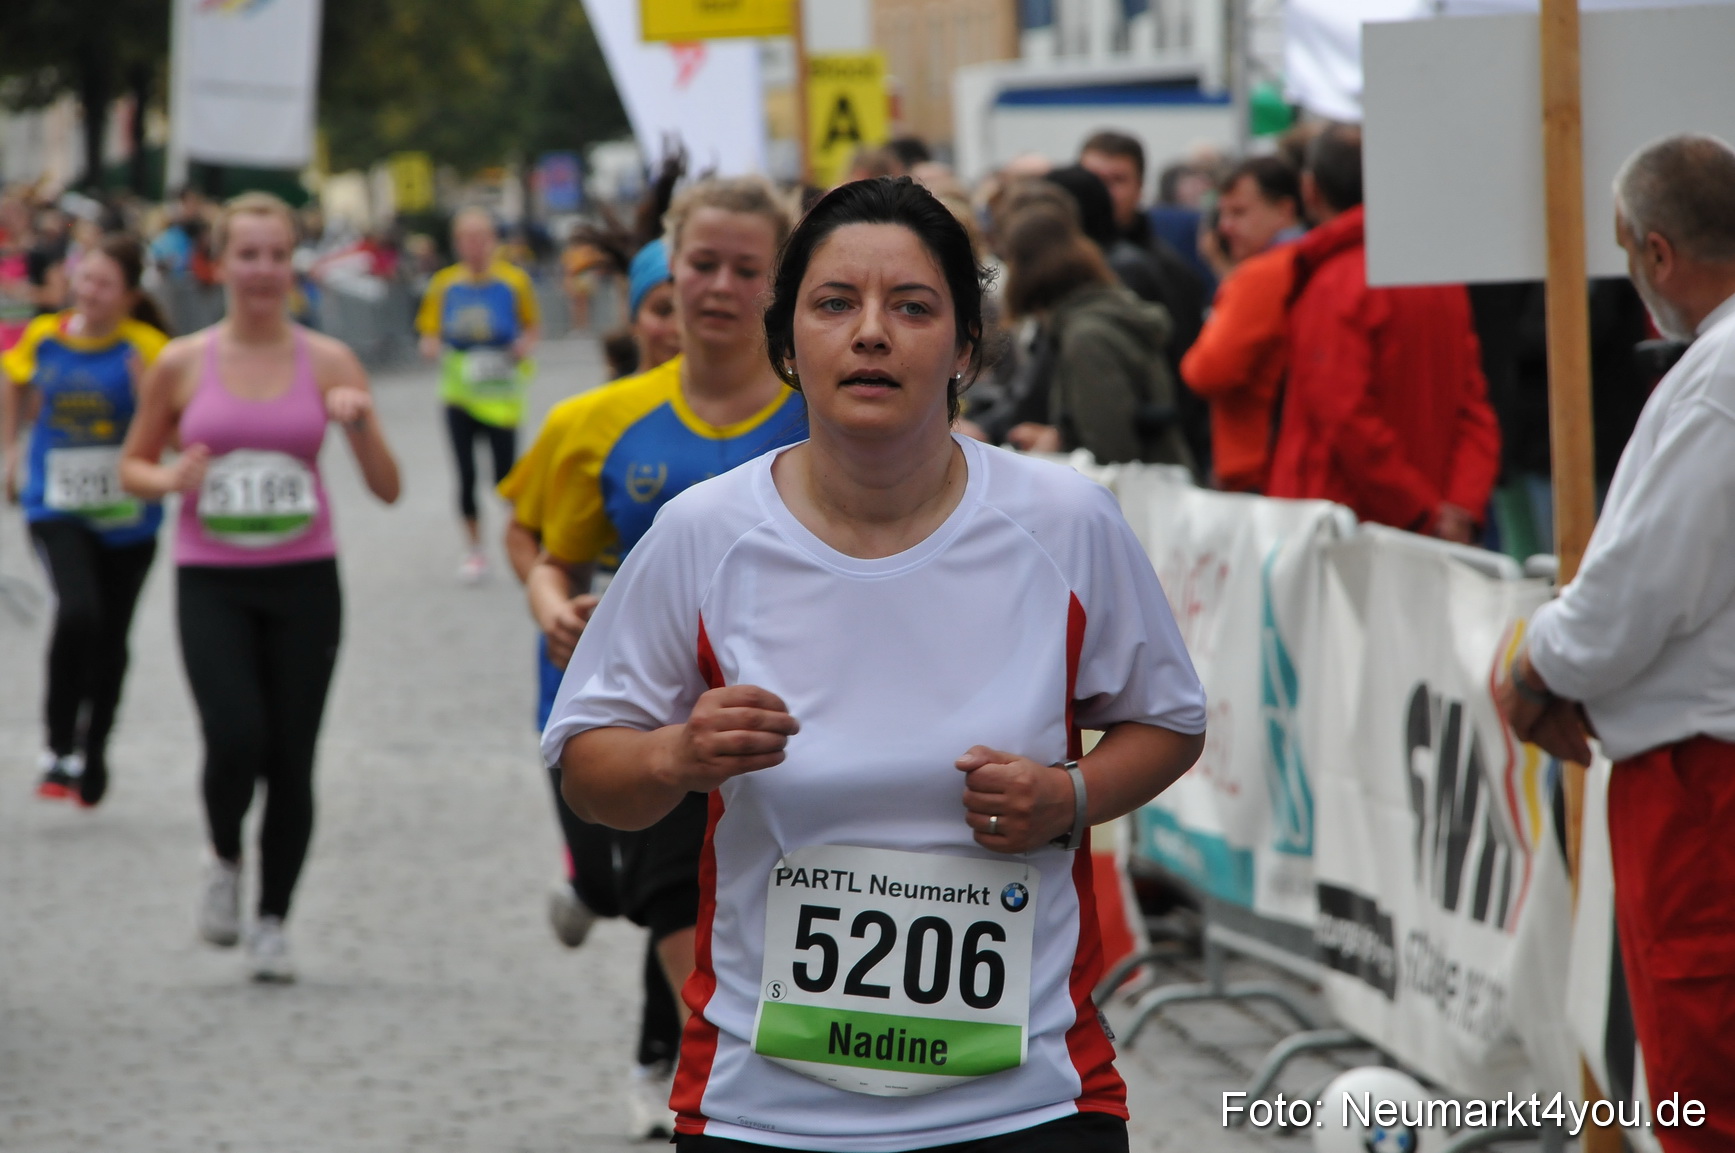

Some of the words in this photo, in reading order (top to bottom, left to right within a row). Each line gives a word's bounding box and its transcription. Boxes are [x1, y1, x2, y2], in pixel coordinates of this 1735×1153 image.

[822, 95, 862, 152] A
[775, 867, 862, 893] PARTL
[869, 874, 990, 906] Neumarkt
[792, 904, 1007, 1010] 5206
[828, 1021, 948, 1067] Nadine
